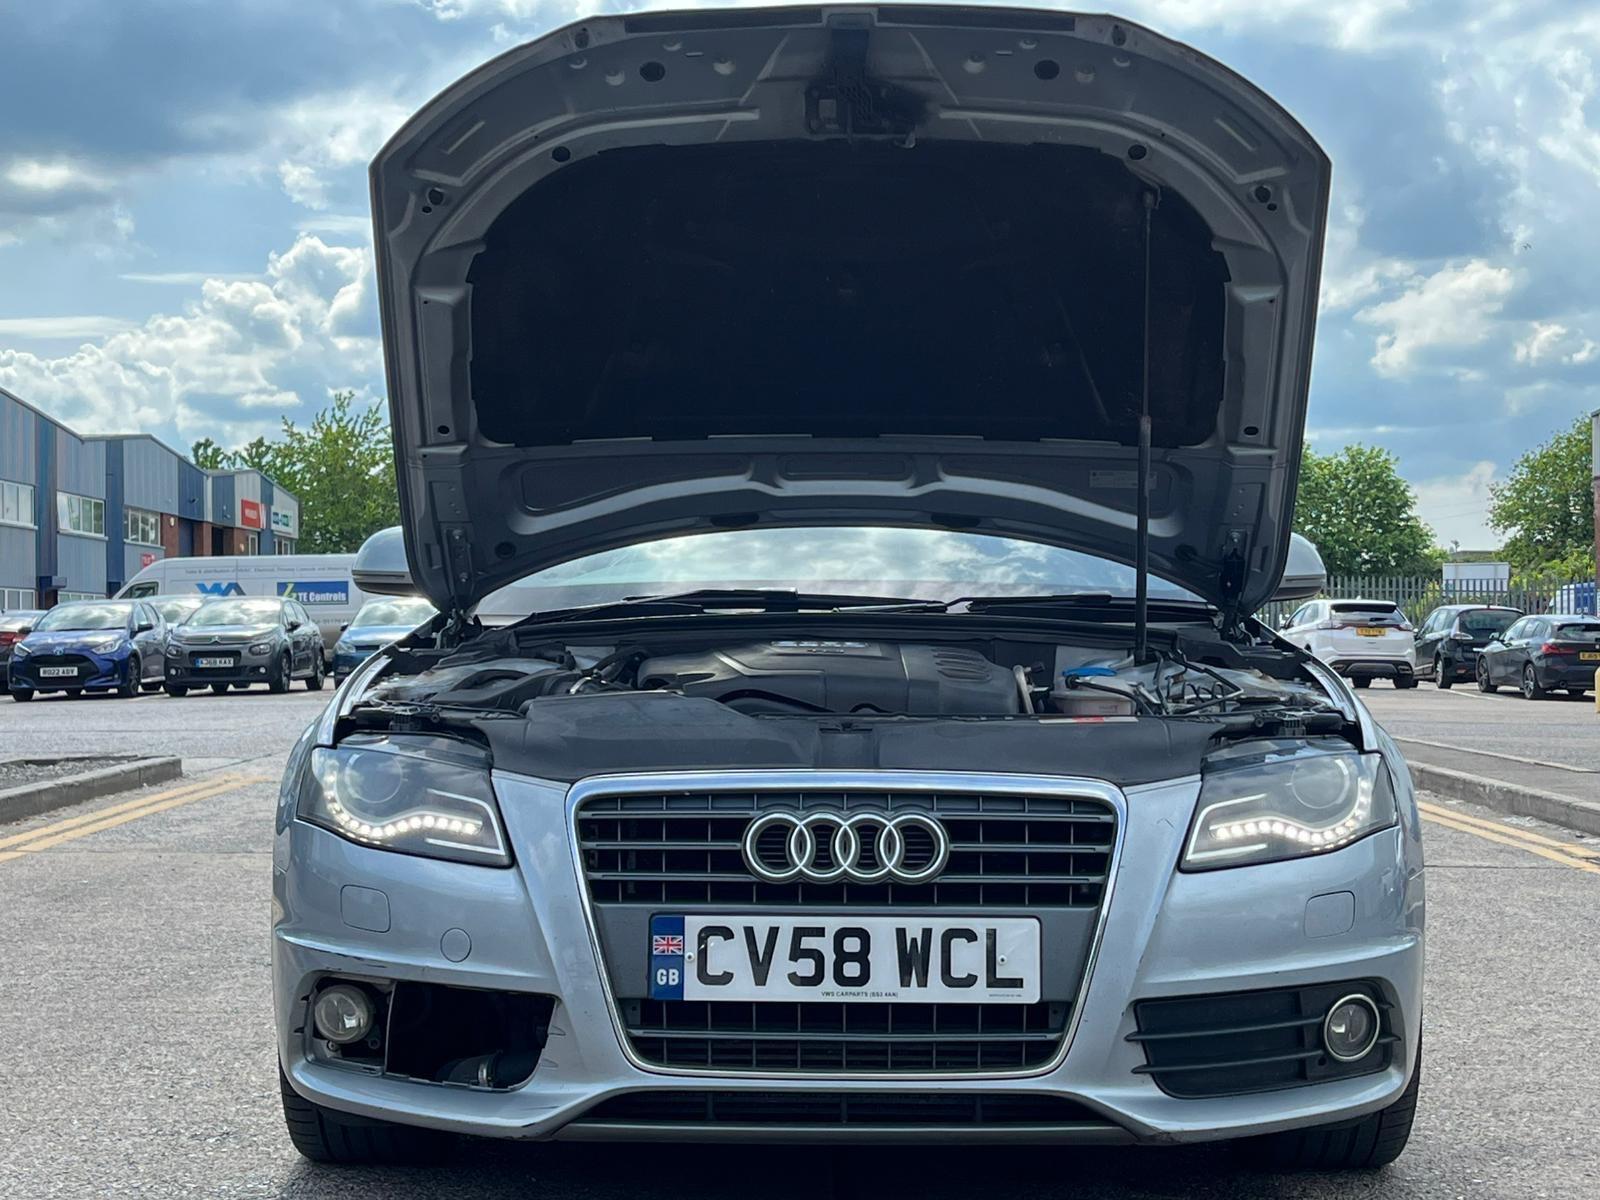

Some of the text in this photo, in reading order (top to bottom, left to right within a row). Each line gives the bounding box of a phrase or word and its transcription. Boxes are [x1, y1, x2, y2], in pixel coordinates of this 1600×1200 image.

[656, 968, 680, 986] GB
[697, 925, 1024, 989] CV58 WCL
